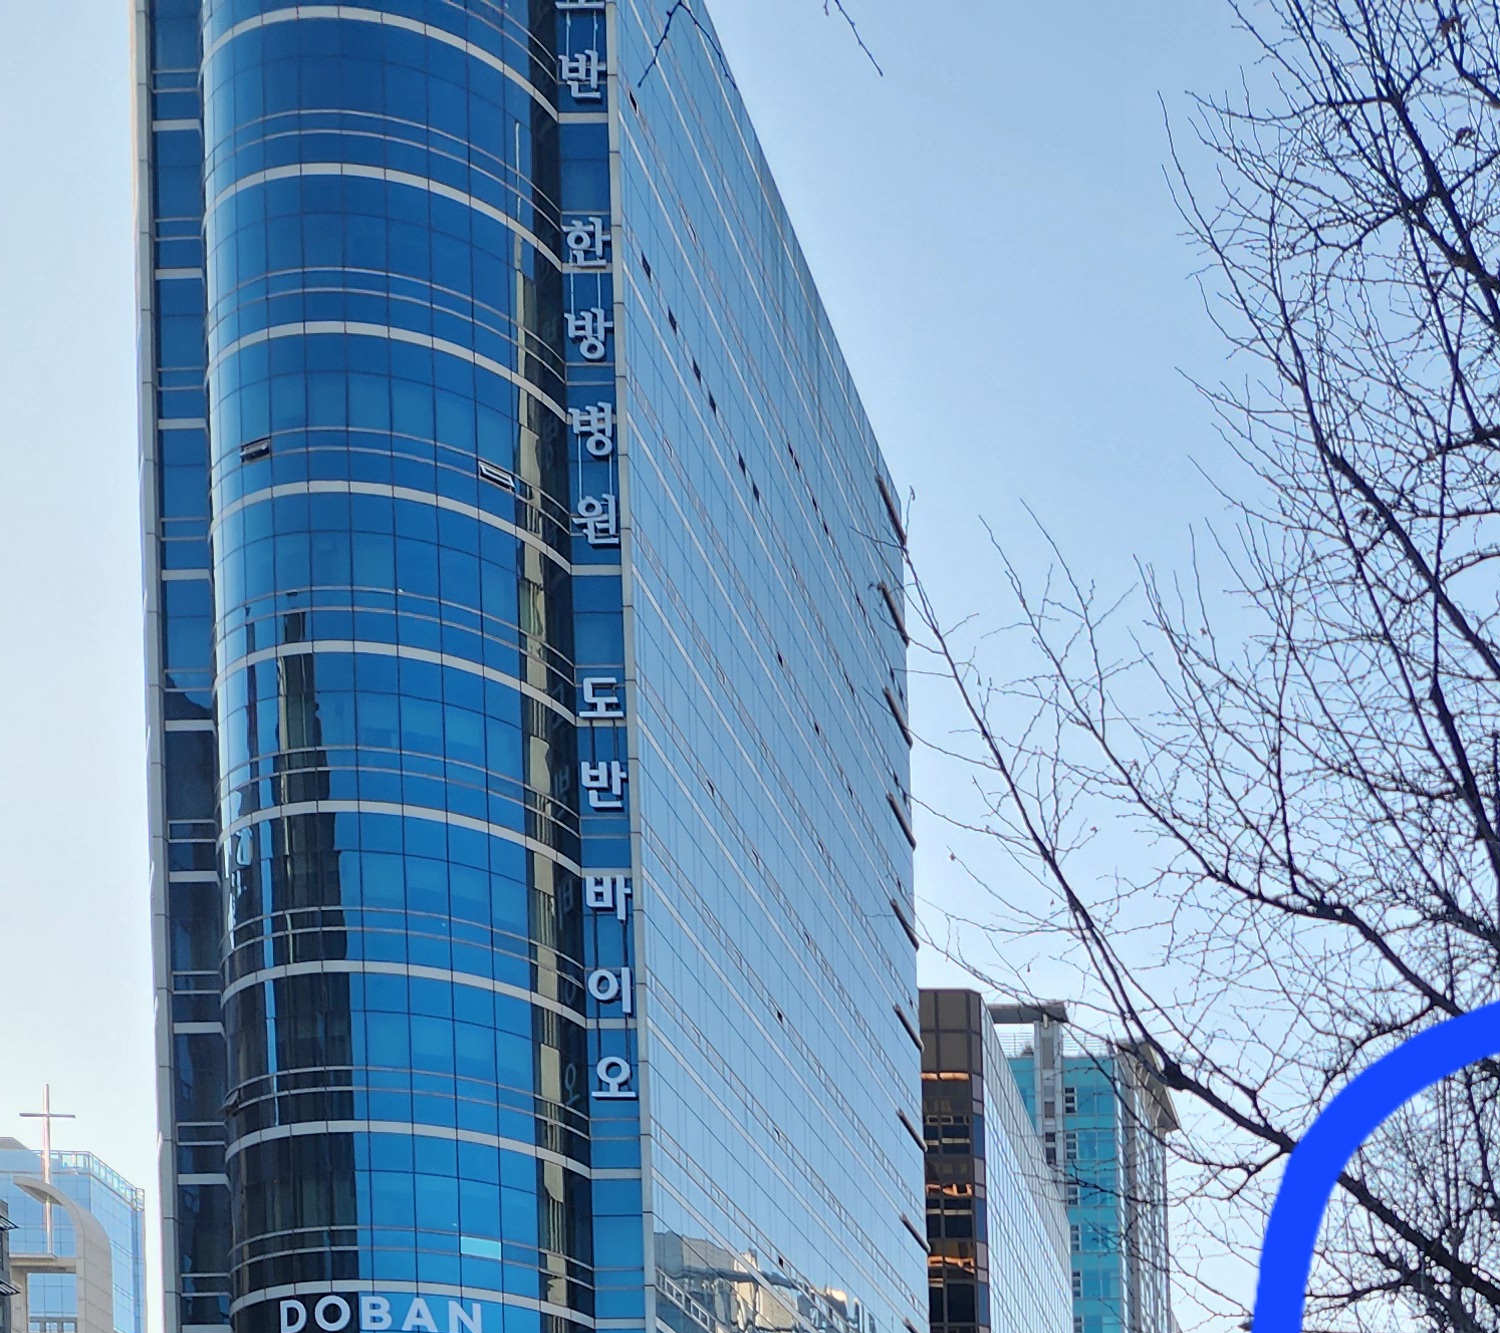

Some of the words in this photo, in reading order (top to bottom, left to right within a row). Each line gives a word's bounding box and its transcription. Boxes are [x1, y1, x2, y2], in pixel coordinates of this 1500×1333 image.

[555, 0, 607, 99] 반
[561, 216, 620, 546] 한방병원
[579, 676, 628, 808] 도반
[584, 874, 639, 1099] 바이오
